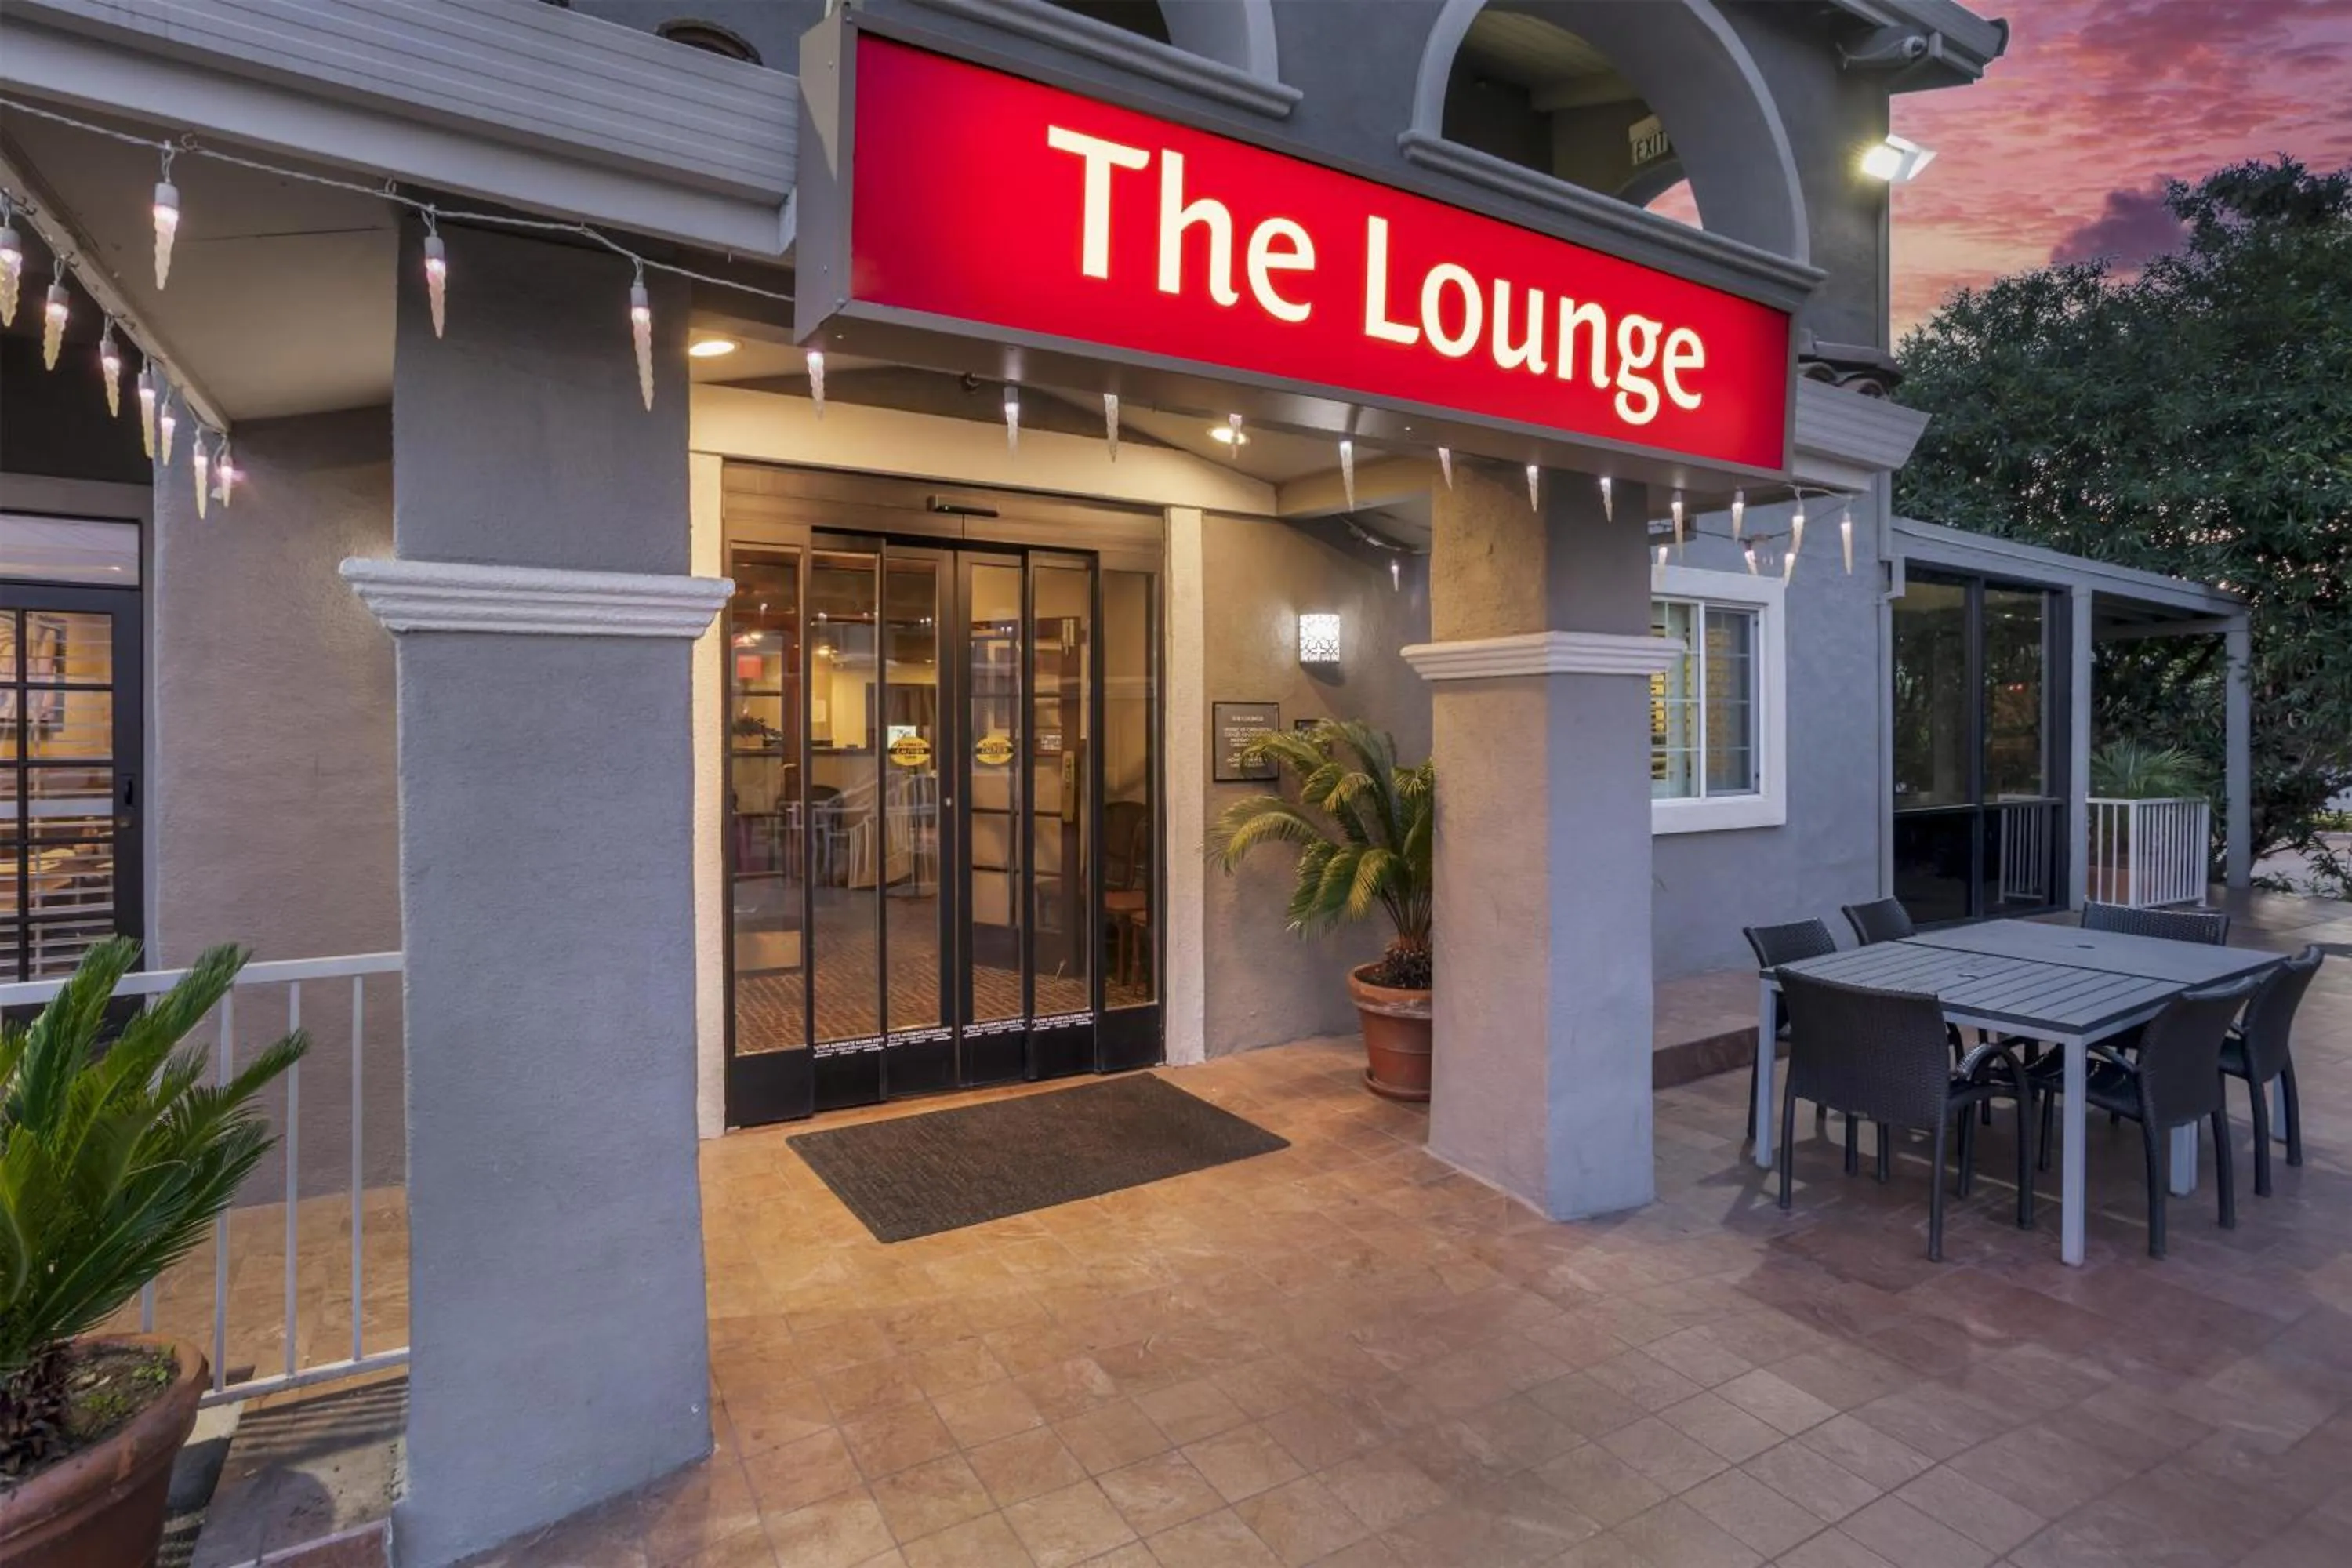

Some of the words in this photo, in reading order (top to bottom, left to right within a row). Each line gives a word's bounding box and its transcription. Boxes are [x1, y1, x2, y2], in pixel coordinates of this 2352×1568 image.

[1636, 131, 1664, 163] EXIT
[1047, 125, 1316, 322] The
[1364, 214, 1706, 425] Lounge
